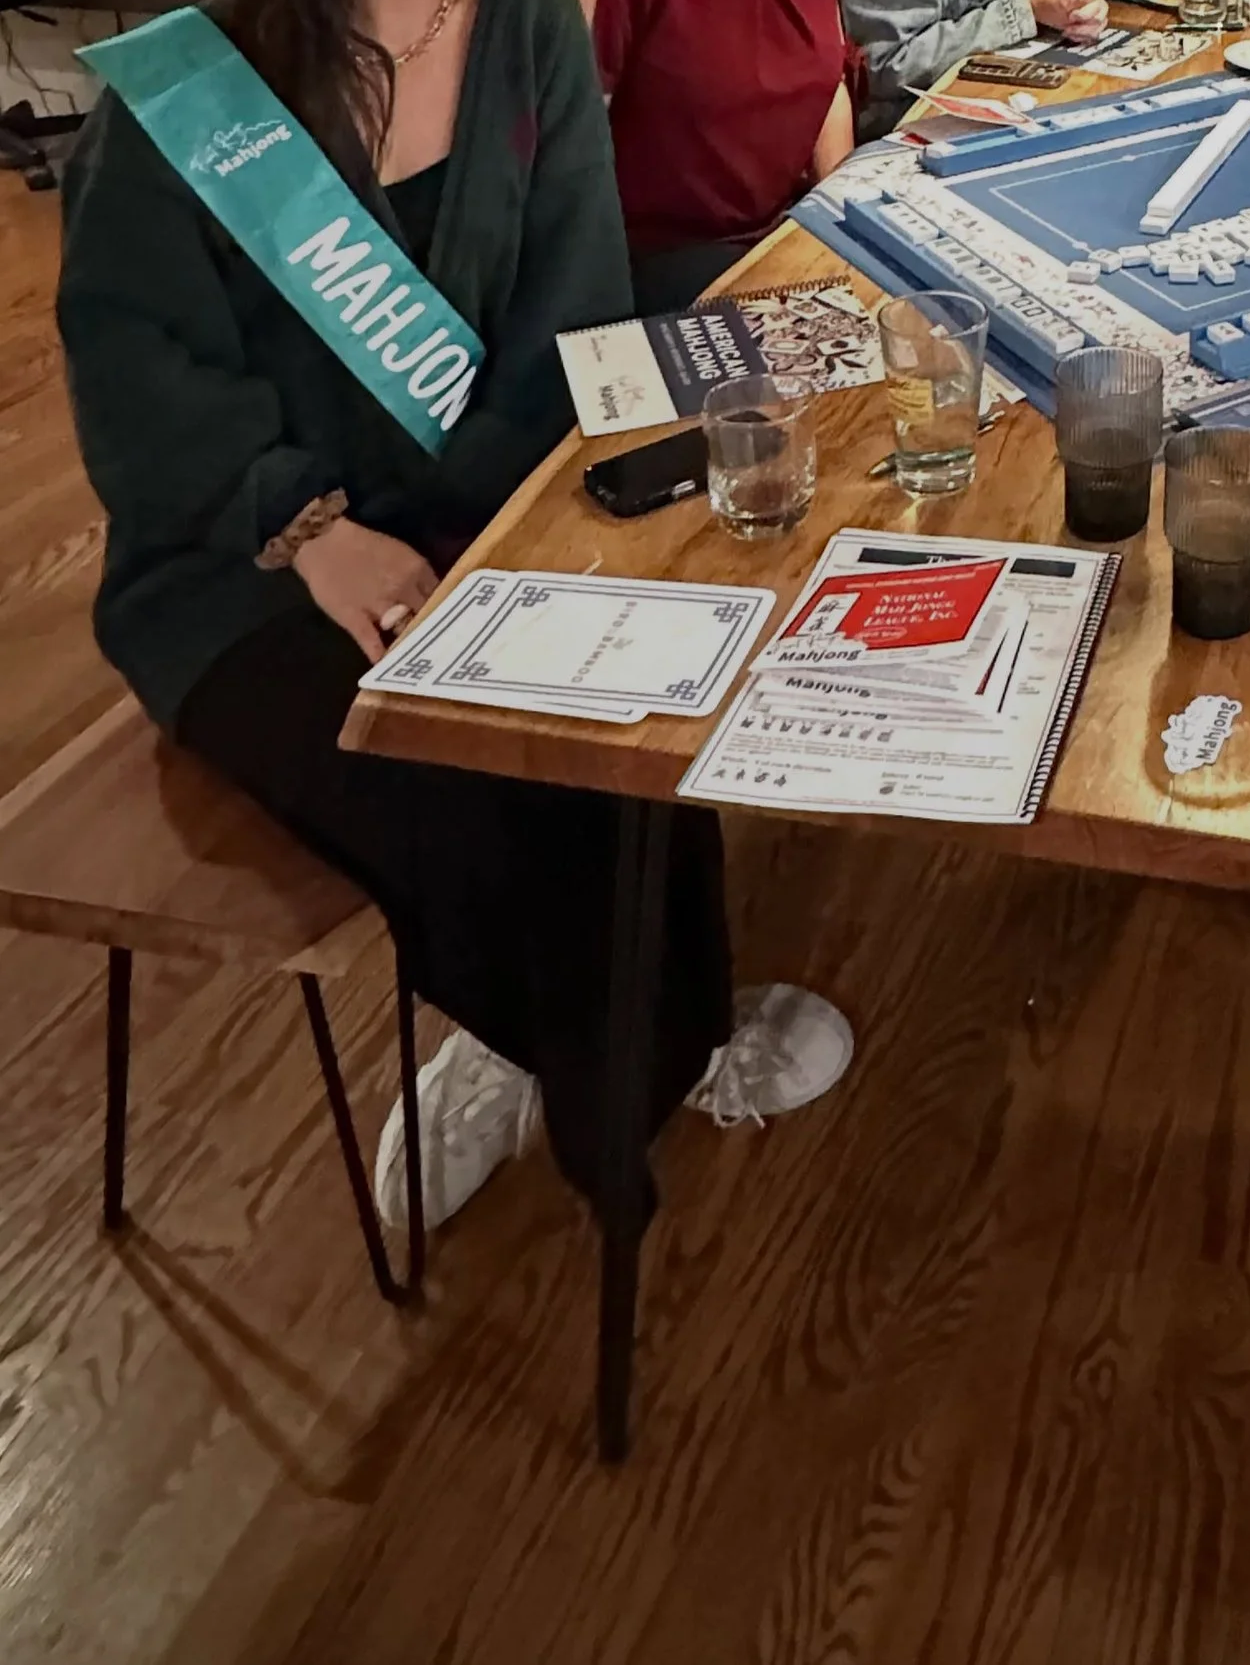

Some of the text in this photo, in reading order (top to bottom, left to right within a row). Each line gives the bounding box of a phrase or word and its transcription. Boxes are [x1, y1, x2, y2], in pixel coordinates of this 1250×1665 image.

[214, 124, 292, 177] Mahjong
[676, 317, 722, 381] MAHJONG
[701, 314, 750, 379] AMERICAN
[778, 649, 862, 664] Mahjong
[1195, 702, 1238, 760] Mahjong
